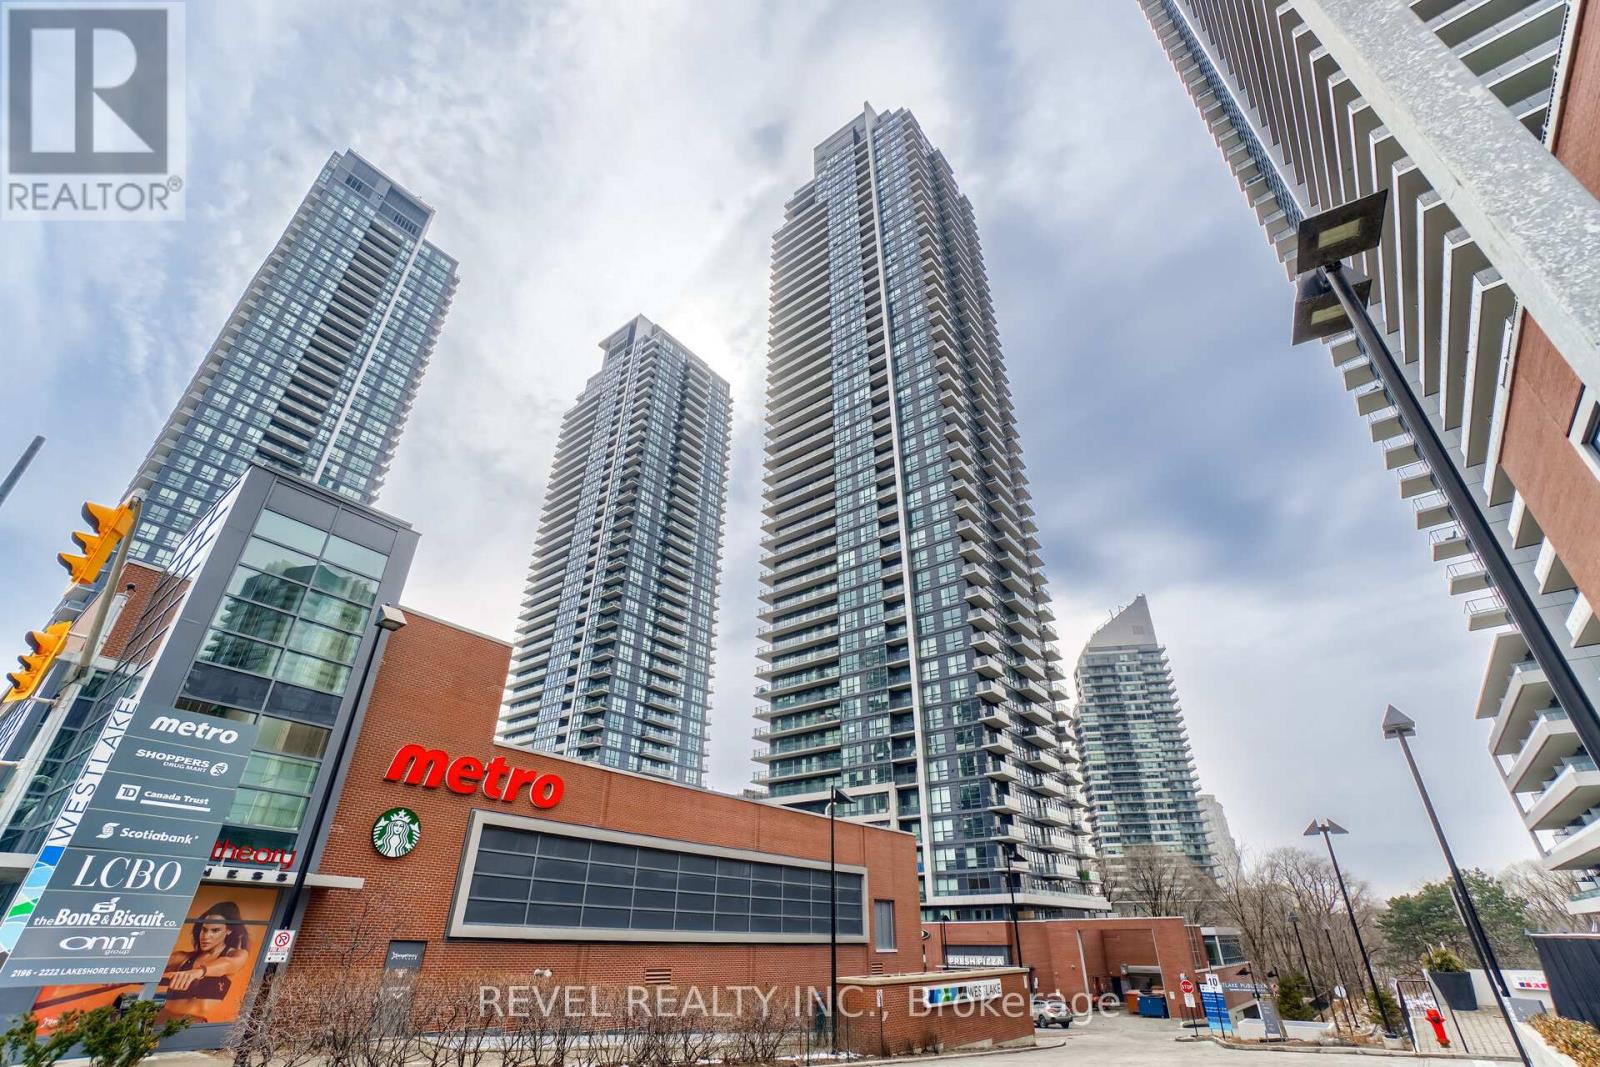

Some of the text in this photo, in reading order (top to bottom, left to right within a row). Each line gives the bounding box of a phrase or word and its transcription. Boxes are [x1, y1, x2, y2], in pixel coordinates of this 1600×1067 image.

[149, 716, 239, 744] metro
[135, 748, 210, 768] SHOPPERS
[163, 761, 208, 773] DRUG MART
[49, 701, 138, 842] WESTLAKE
[383, 743, 566, 810] metro
[144, 790, 209, 805] Canada Trust
[120, 827, 193, 844] Scotiabank
[210, 838, 297, 871] theory
[72, 854, 182, 891] LCBO
[34, 916, 55, 926] the
[54, 908, 100, 926] Bone
[101, 914, 110, 925] &
[110, 909, 165, 927] Biscuit
[59, 930, 141, 951] onni
[104, 949, 130, 957] group
[10, 969, 32, 978] 2196
[38, 968, 59, 977] 2222
[60, 967, 109, 976] LAKESHORE
[109, 966, 156, 975] BOULEVARD
[1208, 977, 1218, 987] 10
